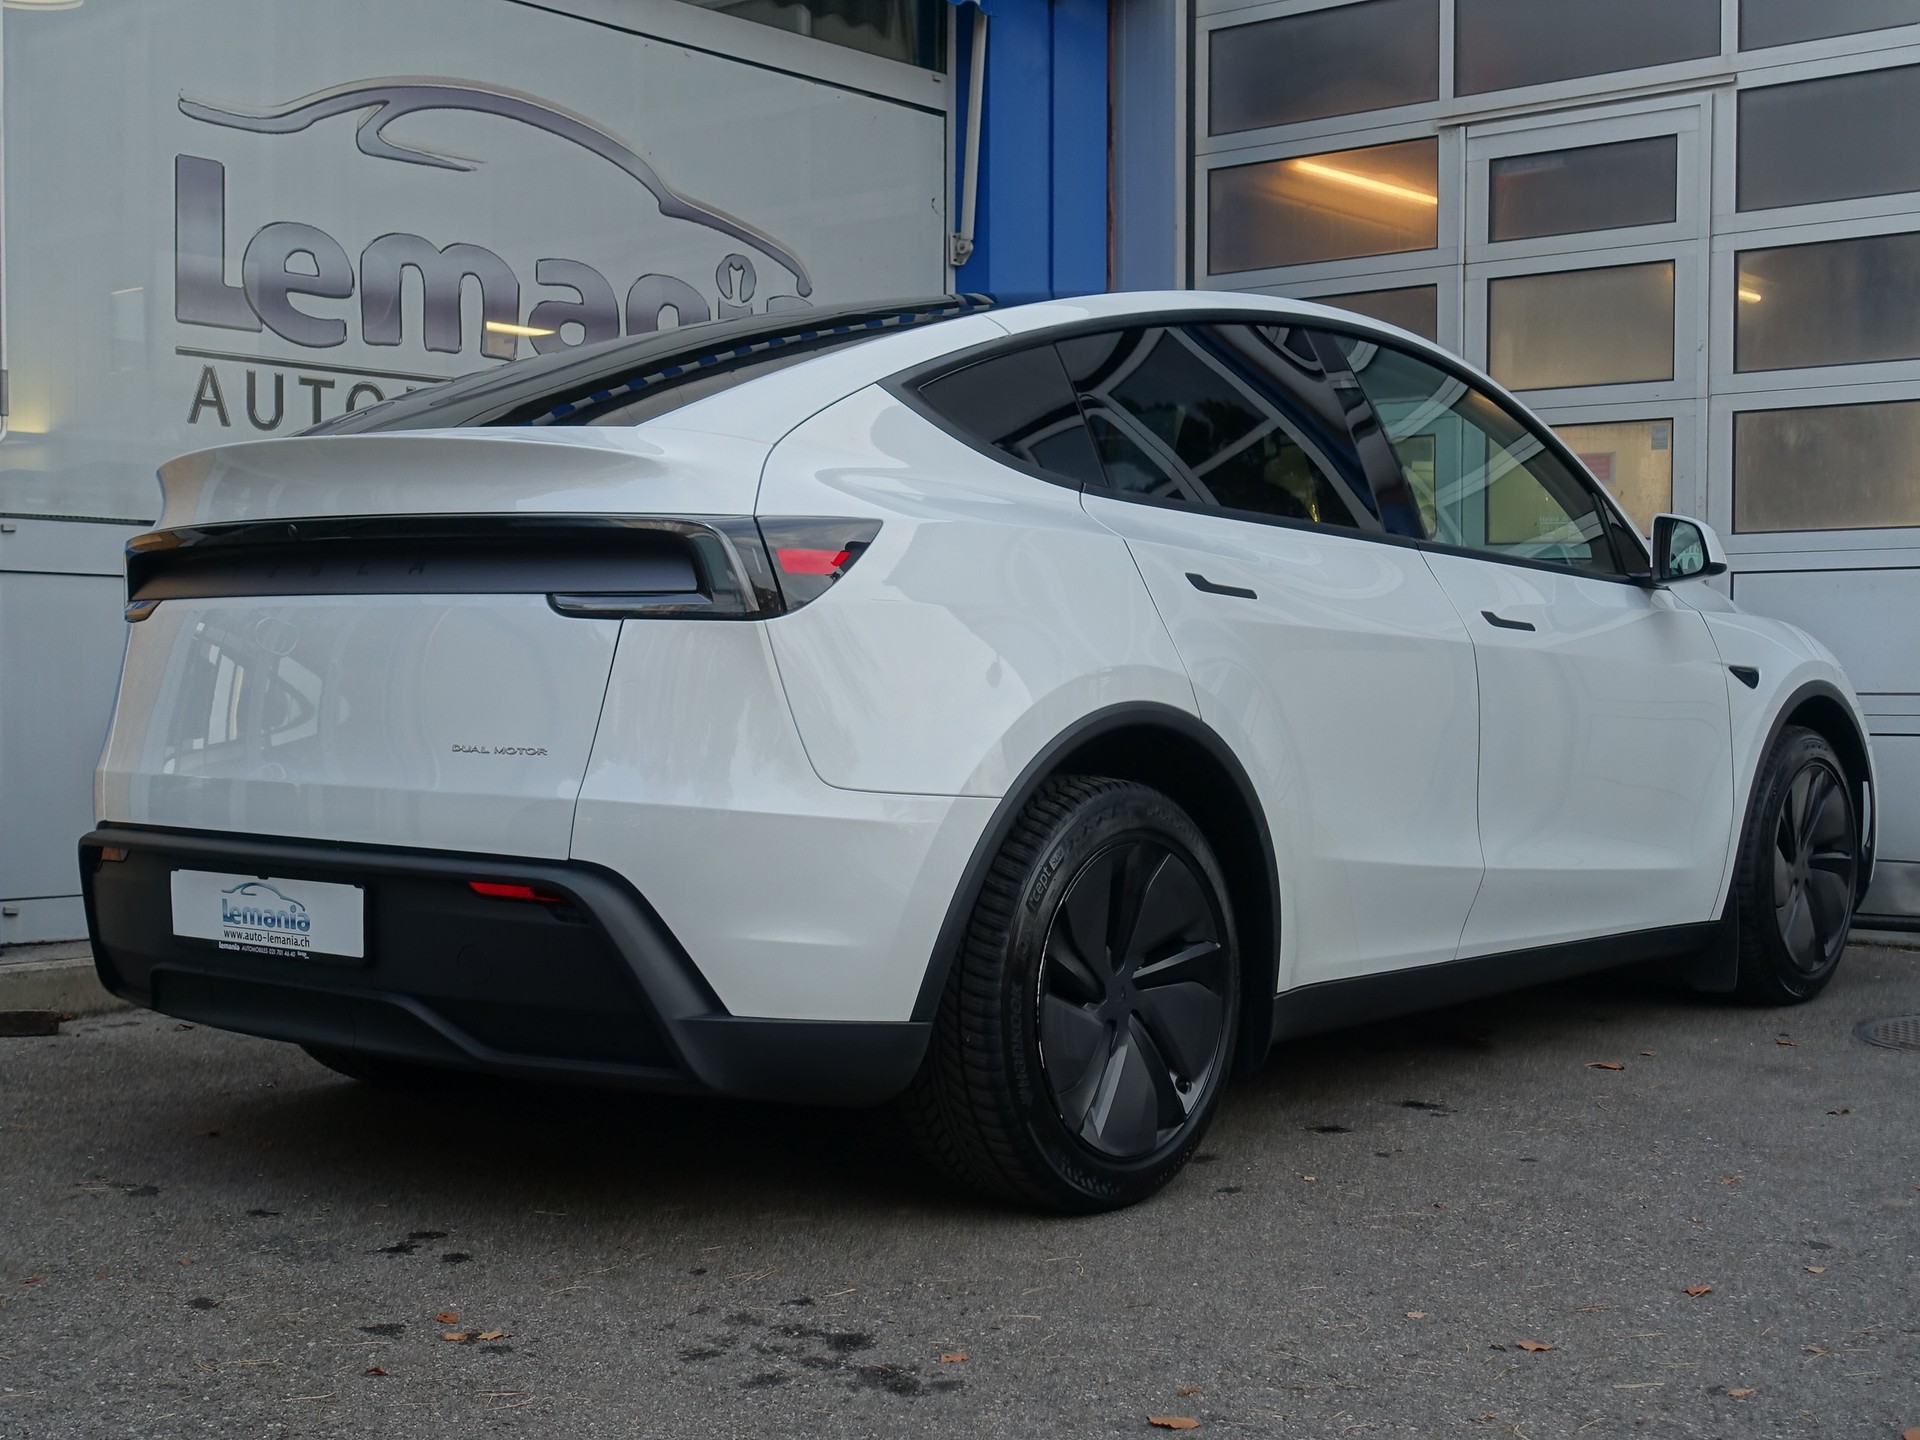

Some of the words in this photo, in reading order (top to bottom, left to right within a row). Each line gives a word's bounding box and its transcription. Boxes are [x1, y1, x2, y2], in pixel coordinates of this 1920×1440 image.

[175, 154, 814, 361] Lemani
[451, 744, 490, 754] DUAL
[493, 746, 548, 756] MOTOR
[222, 898, 310, 932] Lemania
[223, 930, 310, 948] www.auto-lemania.ch
